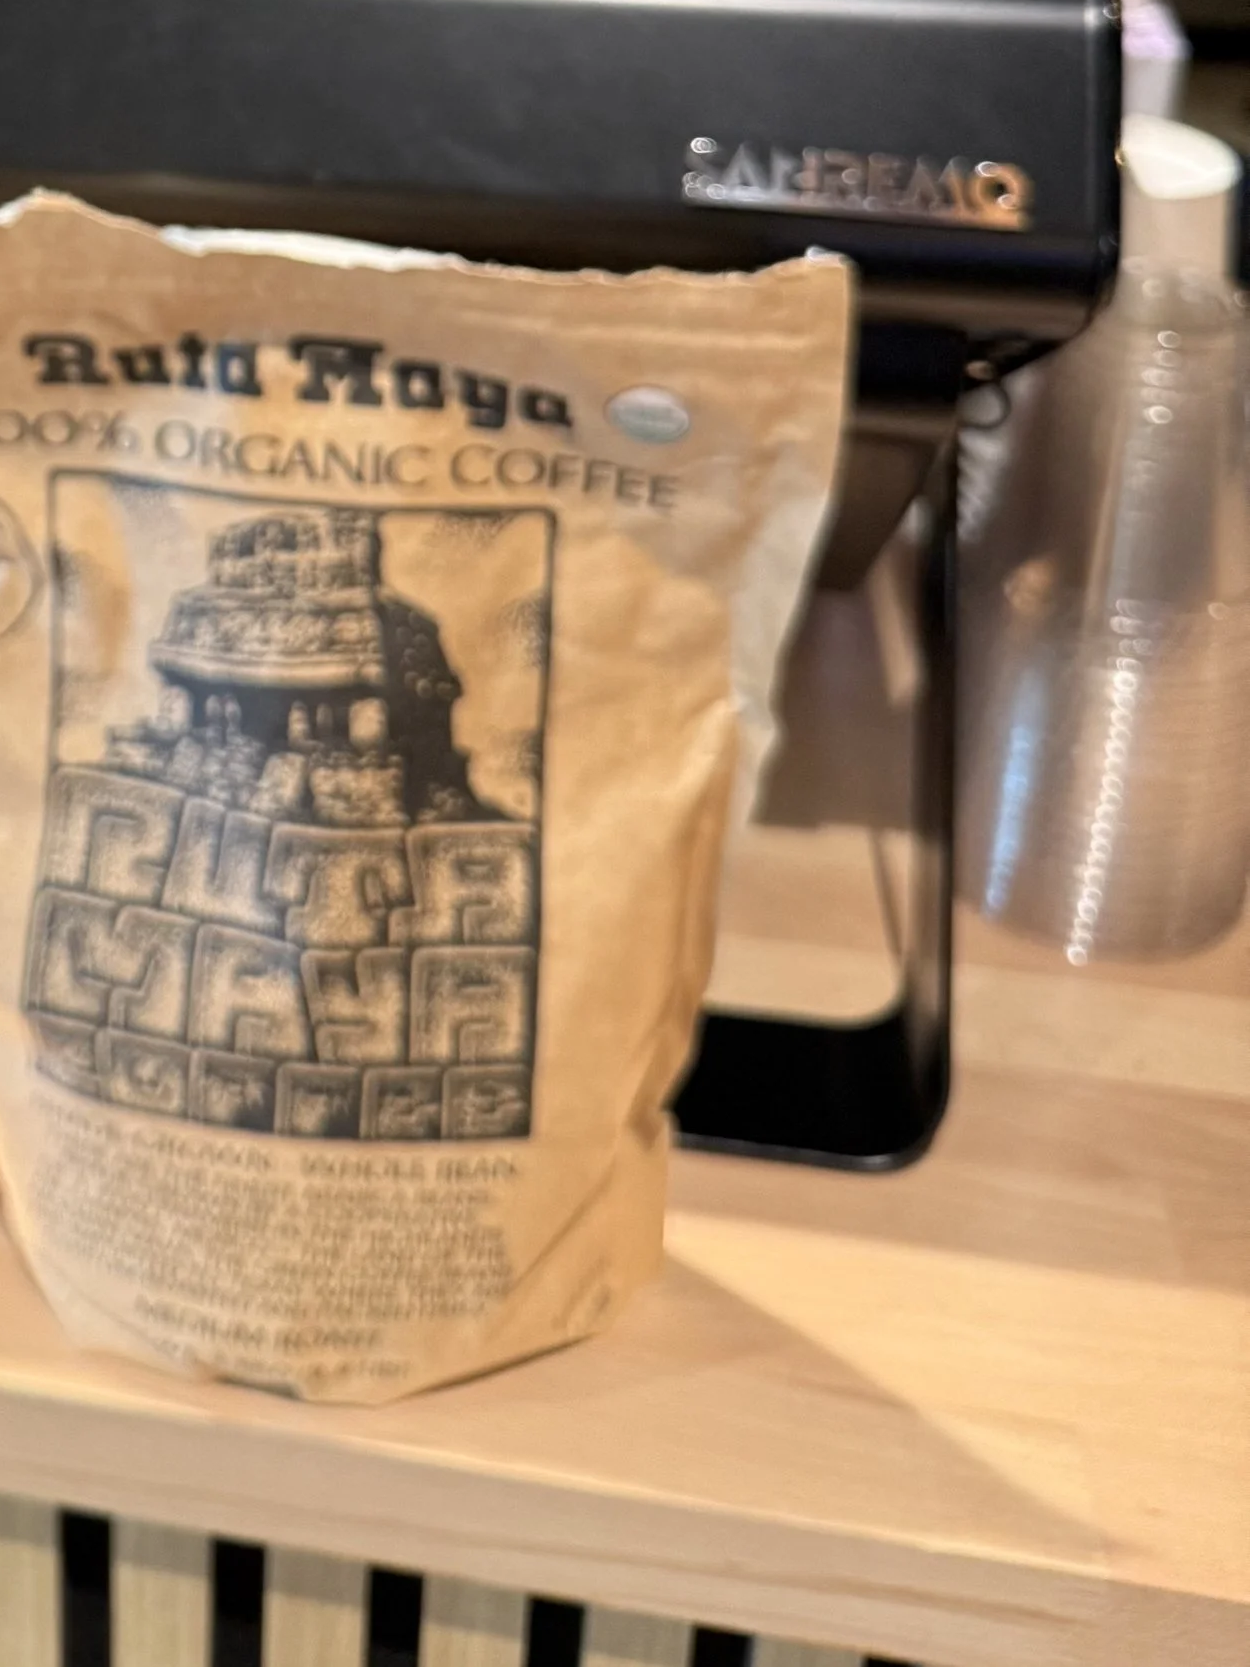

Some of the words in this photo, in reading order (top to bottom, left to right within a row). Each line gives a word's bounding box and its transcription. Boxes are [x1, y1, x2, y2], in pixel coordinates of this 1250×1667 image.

[22, 332, 262, 397] Ruta
[288, 335, 574, 430] Maya
[154, 418, 431, 489] ORGANIC
[450, 442, 682, 510] COFFEE
